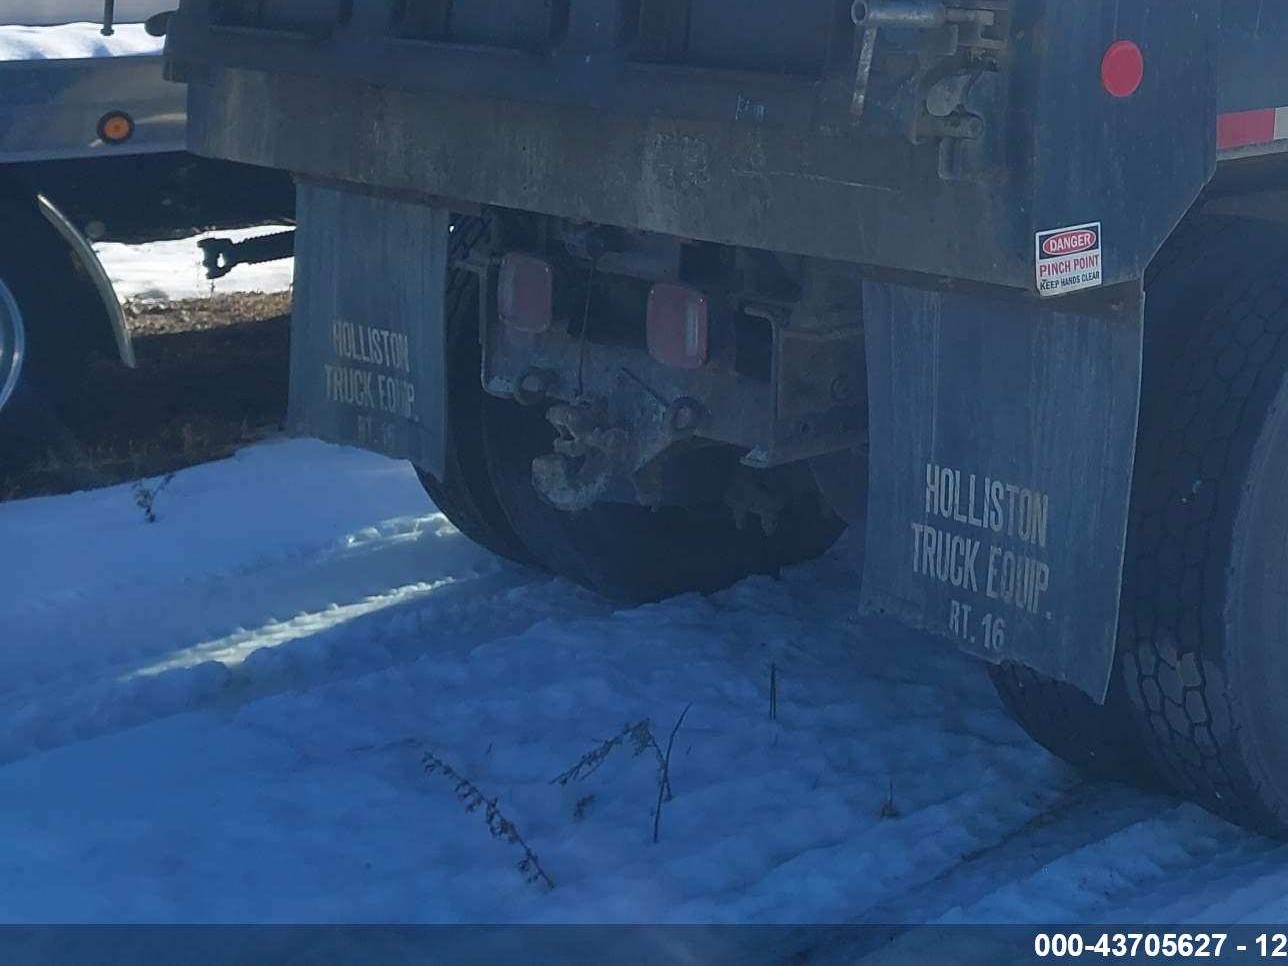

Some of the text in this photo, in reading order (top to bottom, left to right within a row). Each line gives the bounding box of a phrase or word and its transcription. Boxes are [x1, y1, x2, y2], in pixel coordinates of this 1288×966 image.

[1049, 233, 1091, 252] DANGER
[1040, 254, 1099, 277] PINCH POINT
[1040, 271, 1100, 290] KEEP HANDS CLEAR
[324, 364, 375, 409] TRUCK
[925, 463, 1049, 547] HOLLISTON
[911, 522, 981, 594] TRUCK
[981, 613, 1006, 651] 16
